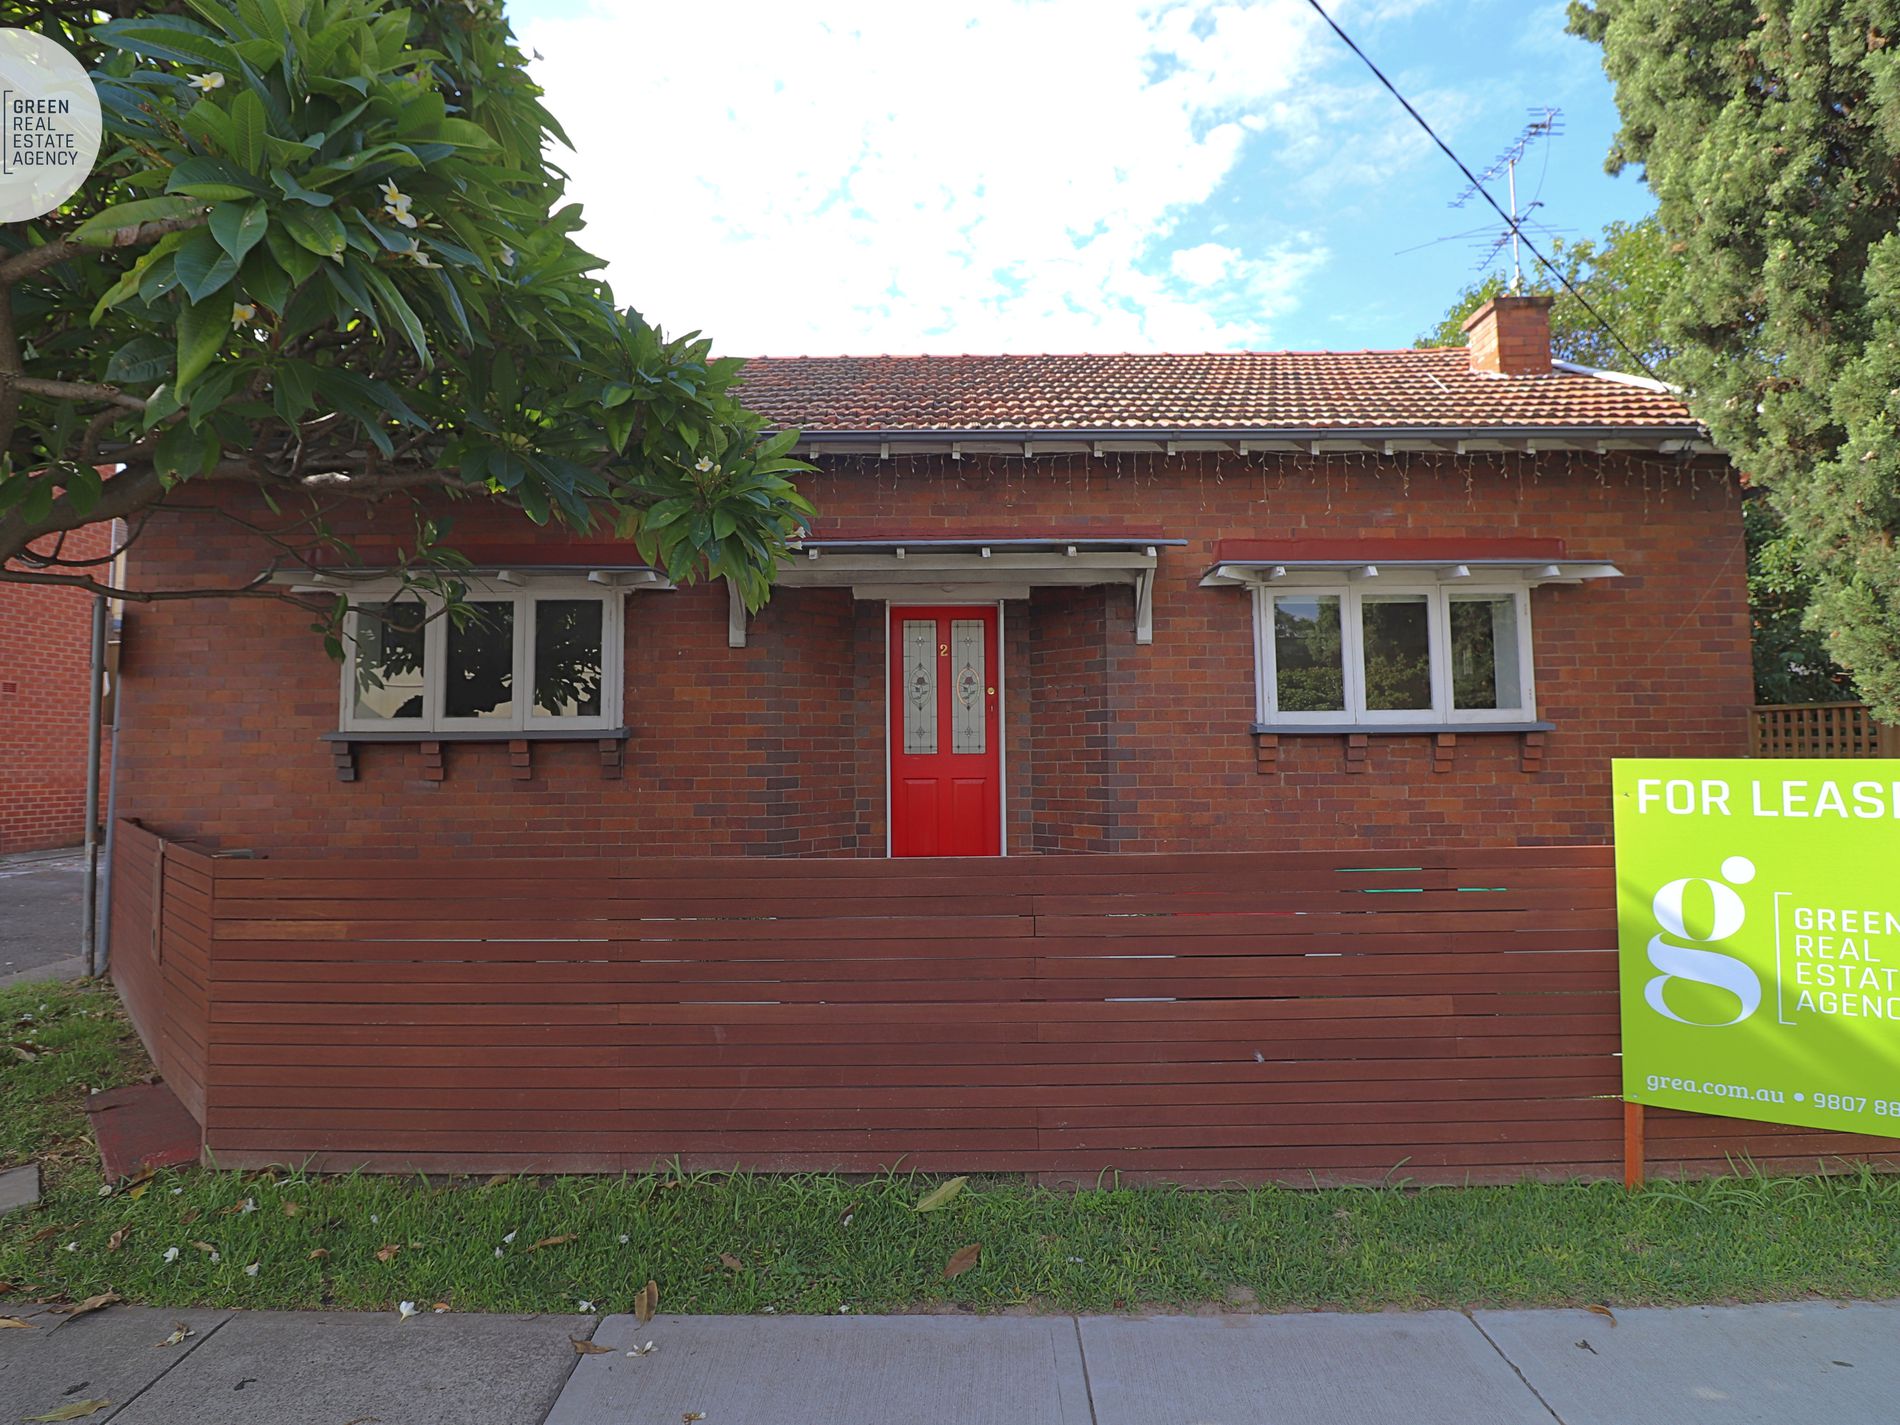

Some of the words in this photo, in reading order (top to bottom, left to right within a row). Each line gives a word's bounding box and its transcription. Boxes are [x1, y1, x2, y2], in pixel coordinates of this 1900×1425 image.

[940, 644, 948, 657] 2
[1637, 778, 1730, 816] FOR
[1794, 907, 1900, 935] GREEN
[1795, 934, 1881, 962] REAL
[1646, 1073, 1785, 1105] grea.com.au
[1813, 1092, 1867, 1113] 9807
[1873, 1099, 1900, 1117] 88
